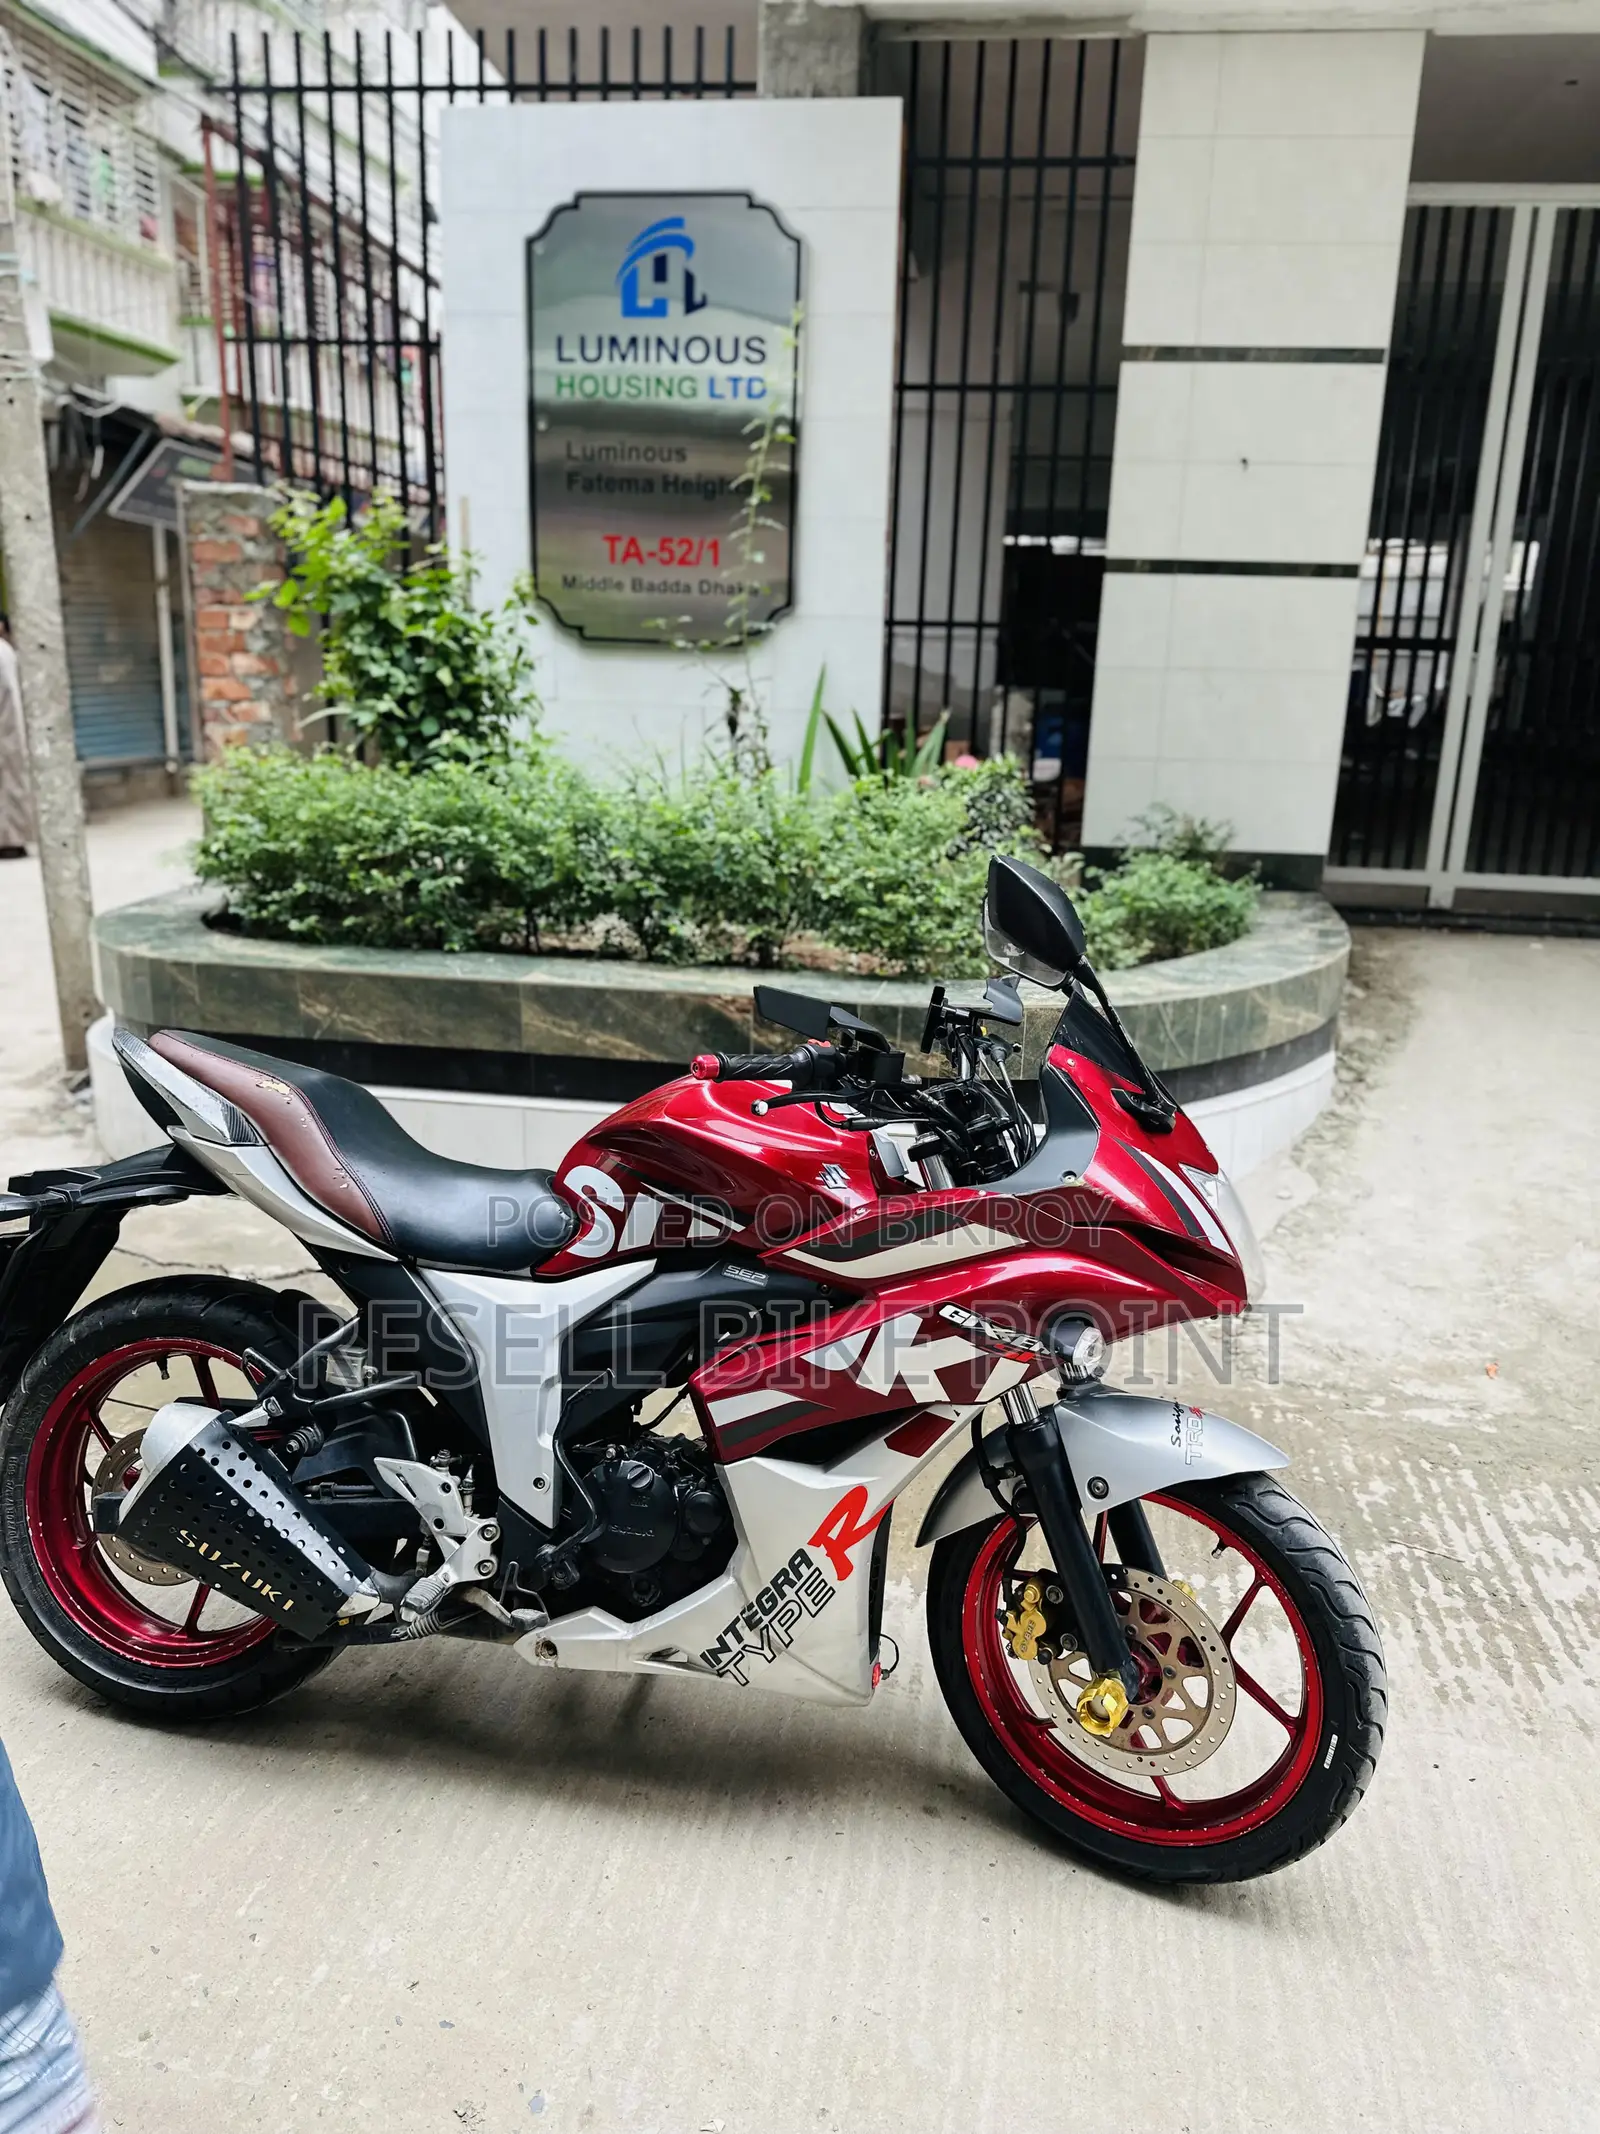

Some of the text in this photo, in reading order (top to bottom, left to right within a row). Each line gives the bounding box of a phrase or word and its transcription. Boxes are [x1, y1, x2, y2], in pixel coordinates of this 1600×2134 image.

[556, 335, 767, 365] LUMINOUS
[556, 374, 768, 400] HOUSING LTD
[566, 440, 688, 463] Luminous
[566, 471, 655, 494] Fatema
[603, 534, 721, 568] TA-52/1
[562, 574, 625, 594] Middle
[631, 577, 692, 595] Badda
[1184, 1416, 1204, 1466] TRD
[176, 1529, 295, 1612] SUZUKI
[699, 1547, 815, 1669] INTEGRA
[716, 1566, 836, 1688] TYPE
